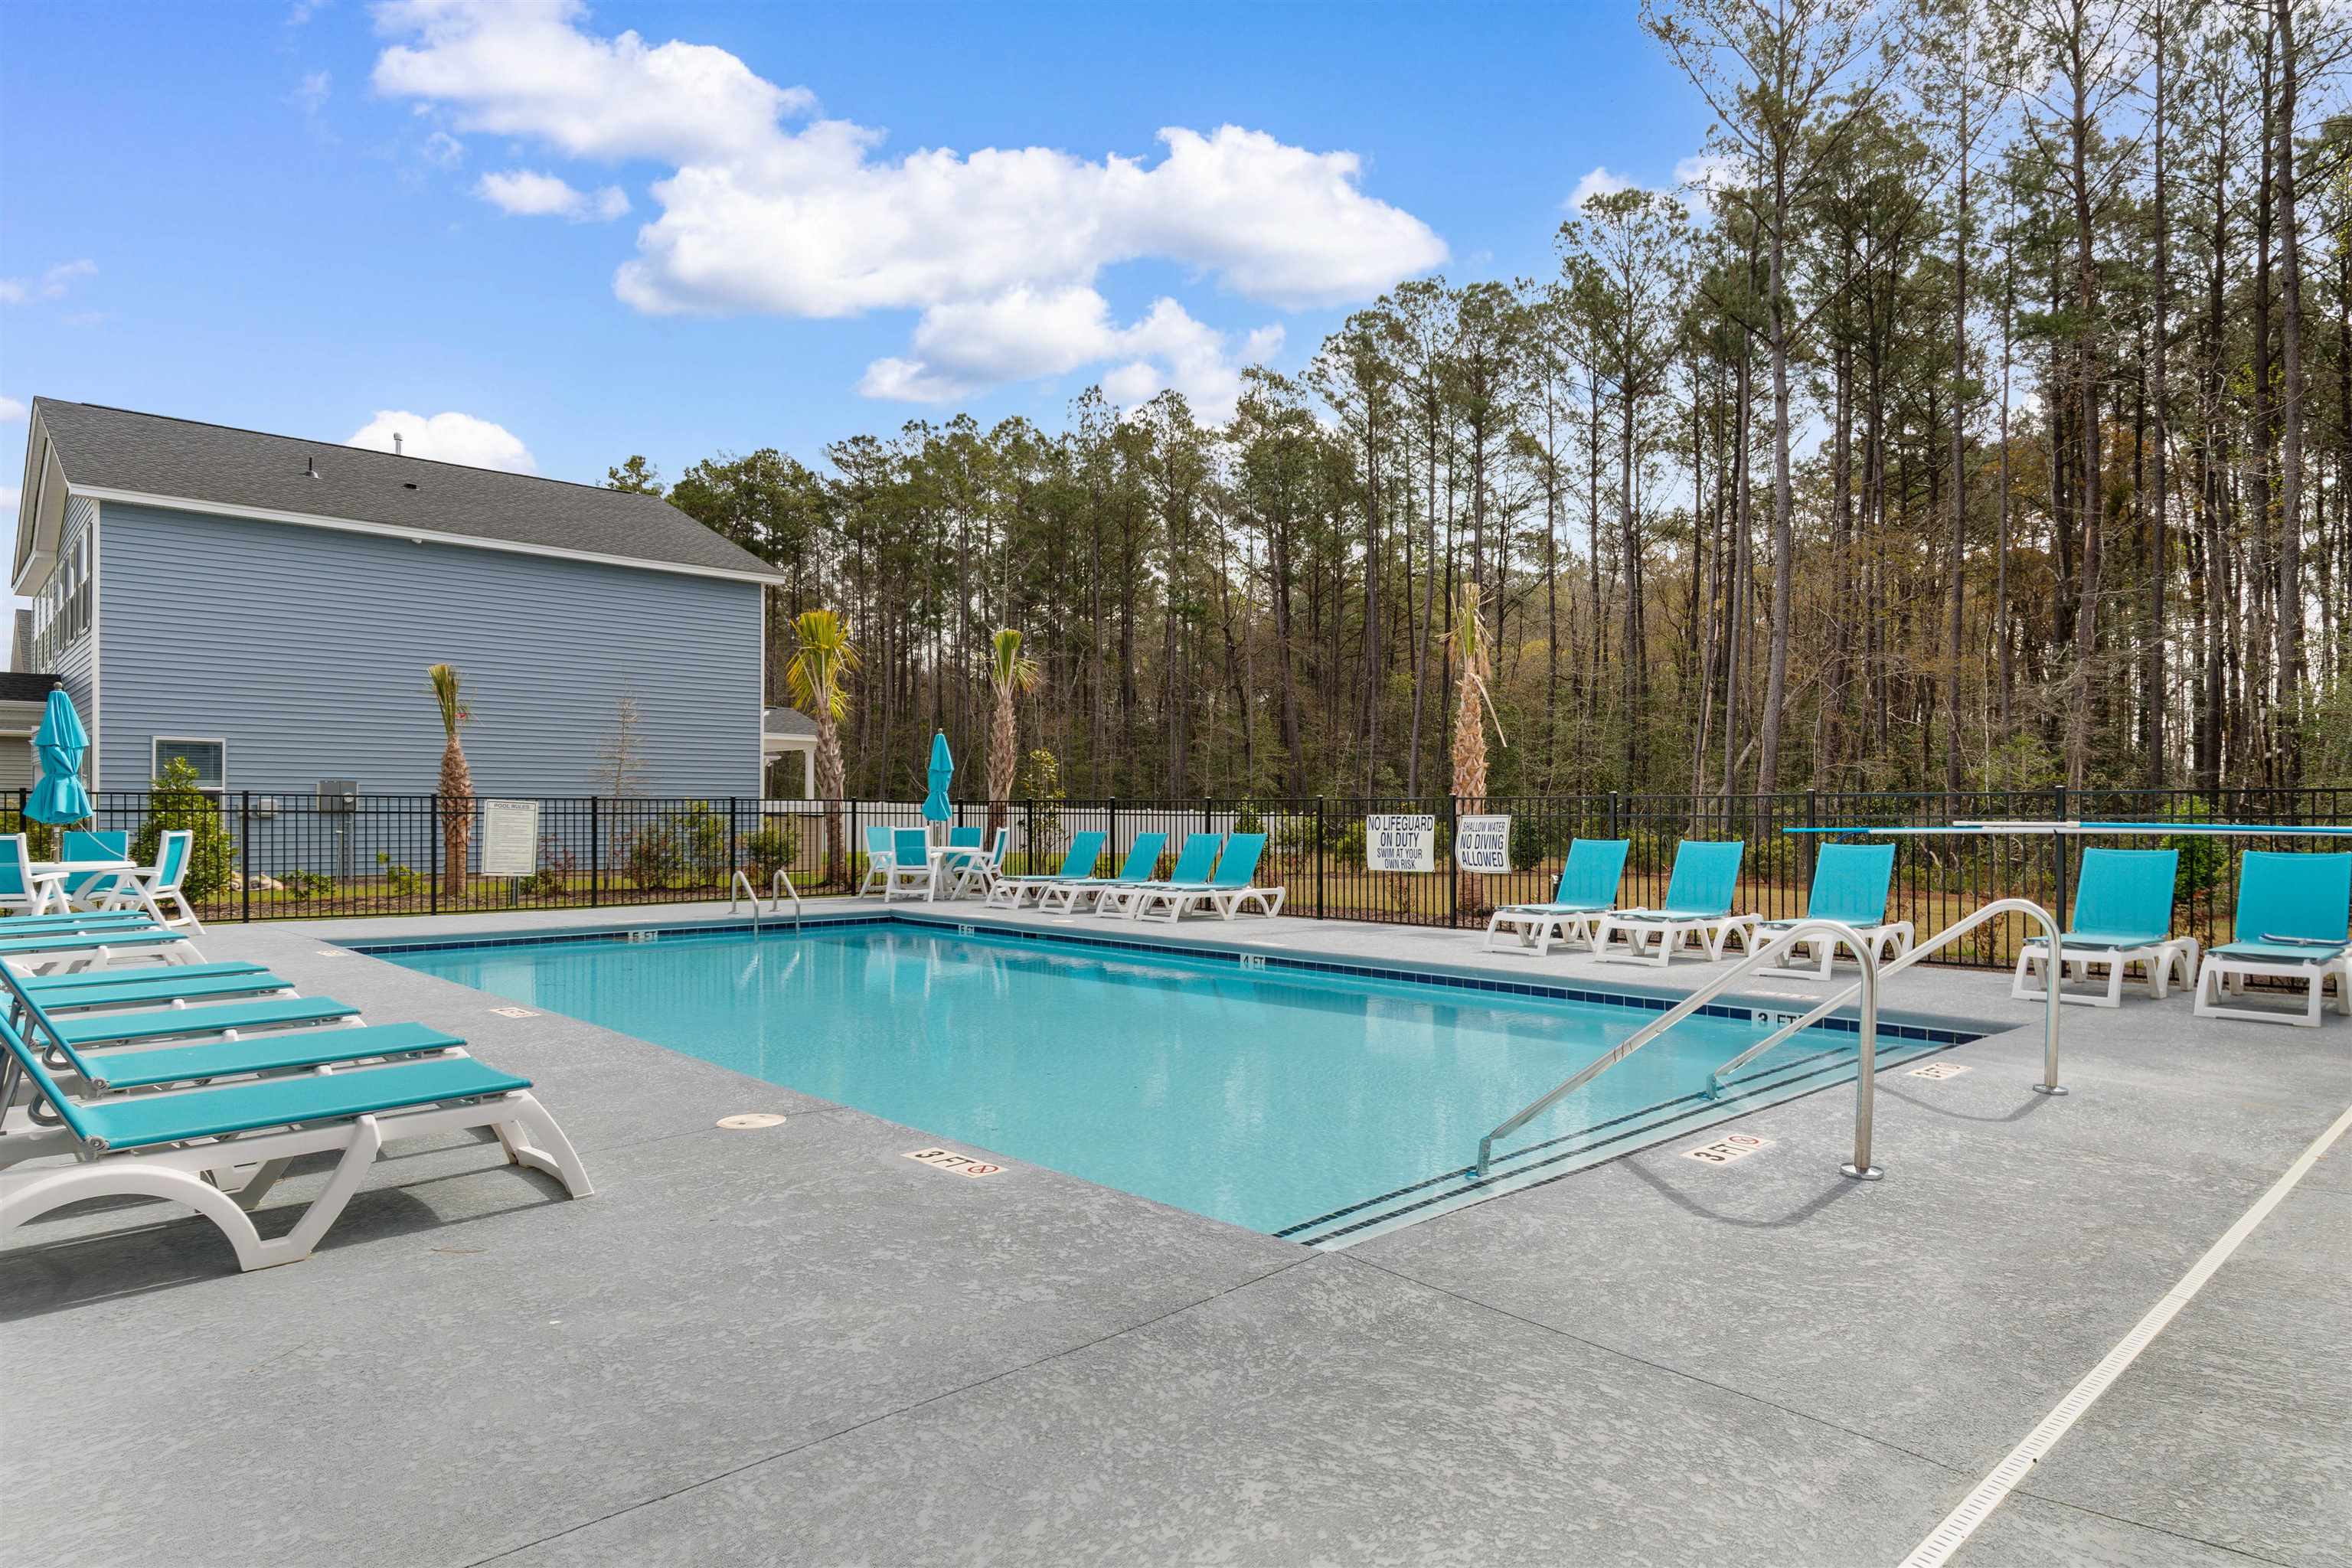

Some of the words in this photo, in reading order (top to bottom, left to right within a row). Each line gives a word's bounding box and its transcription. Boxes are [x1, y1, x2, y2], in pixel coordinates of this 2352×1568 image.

[1368, 816, 1381, 831] NO
[1383, 816, 1433, 831] LIFEGUARD
[1463, 822, 1488, 832] SHALLOW
[1488, 822, 1506, 833] WATER
[1380, 832, 1393, 847] ON
[1396, 832, 1419, 848] DUTY
[1460, 834, 1472, 849] NO
[1475, 834, 1504, 850] DIVING
[1377, 848, 1394, 858] SWIM
[1396, 848, 1403, 858] AT
[1406, 848, 1423, 859] YOUR
[1462, 851, 1504, 867] ALLOWED
[1384, 858, 1400, 869] OWN
[1401, 859, 1416, 870] RISK
[1253, 956, 1264, 965] FT
[1708, 1143, 1749, 1156] FT
[932, 1156, 977, 1168] FT
[1694, 1152, 1726, 1161] 3
